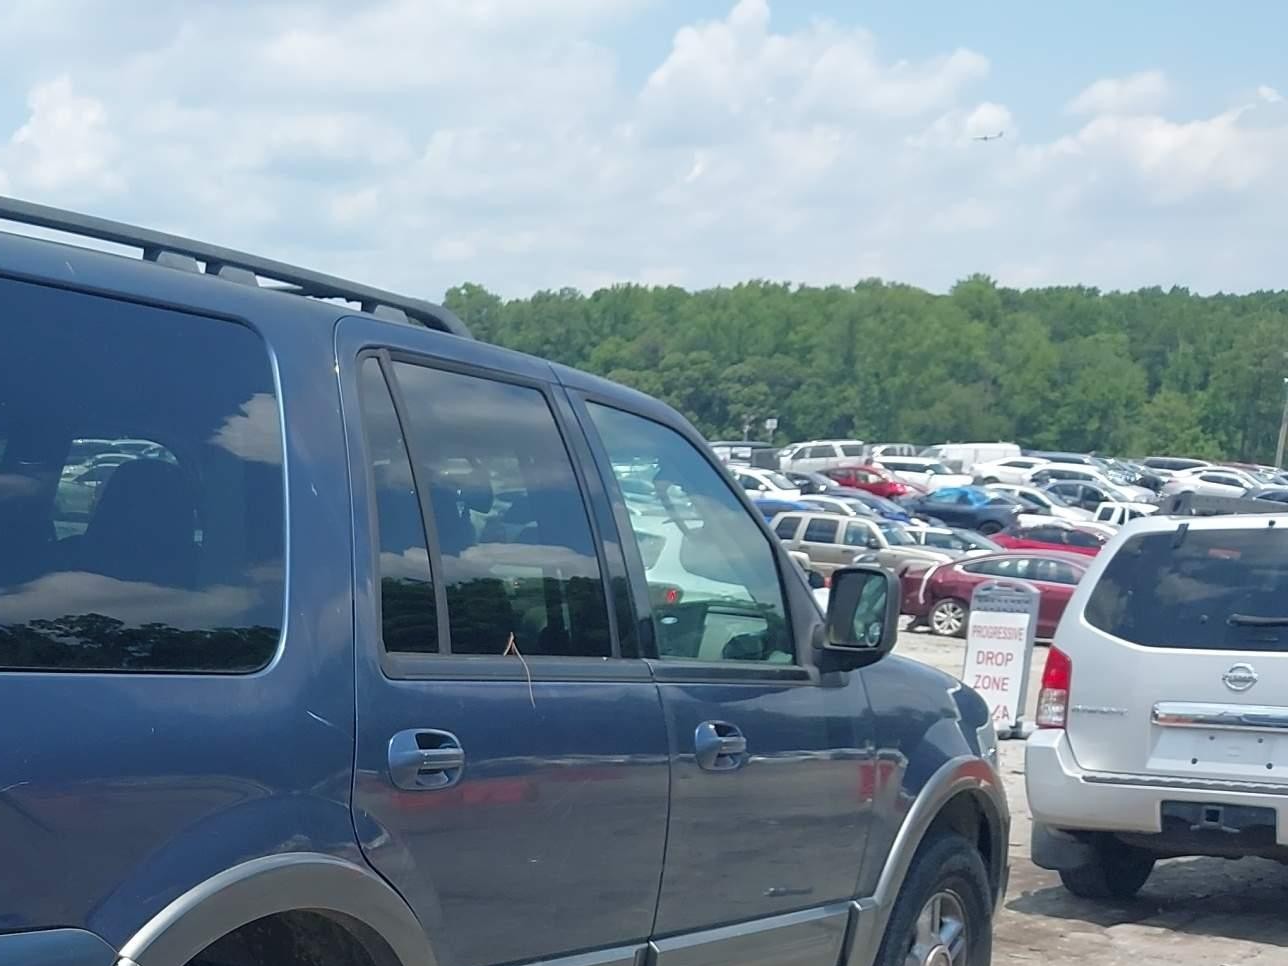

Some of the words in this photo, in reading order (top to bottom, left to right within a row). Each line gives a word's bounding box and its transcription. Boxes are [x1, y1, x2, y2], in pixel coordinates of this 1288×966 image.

[972, 624, 1024, 641] PROGRESSIVE
[976, 650, 1014, 667] DROP
[973, 674, 1010, 692] ZONE
